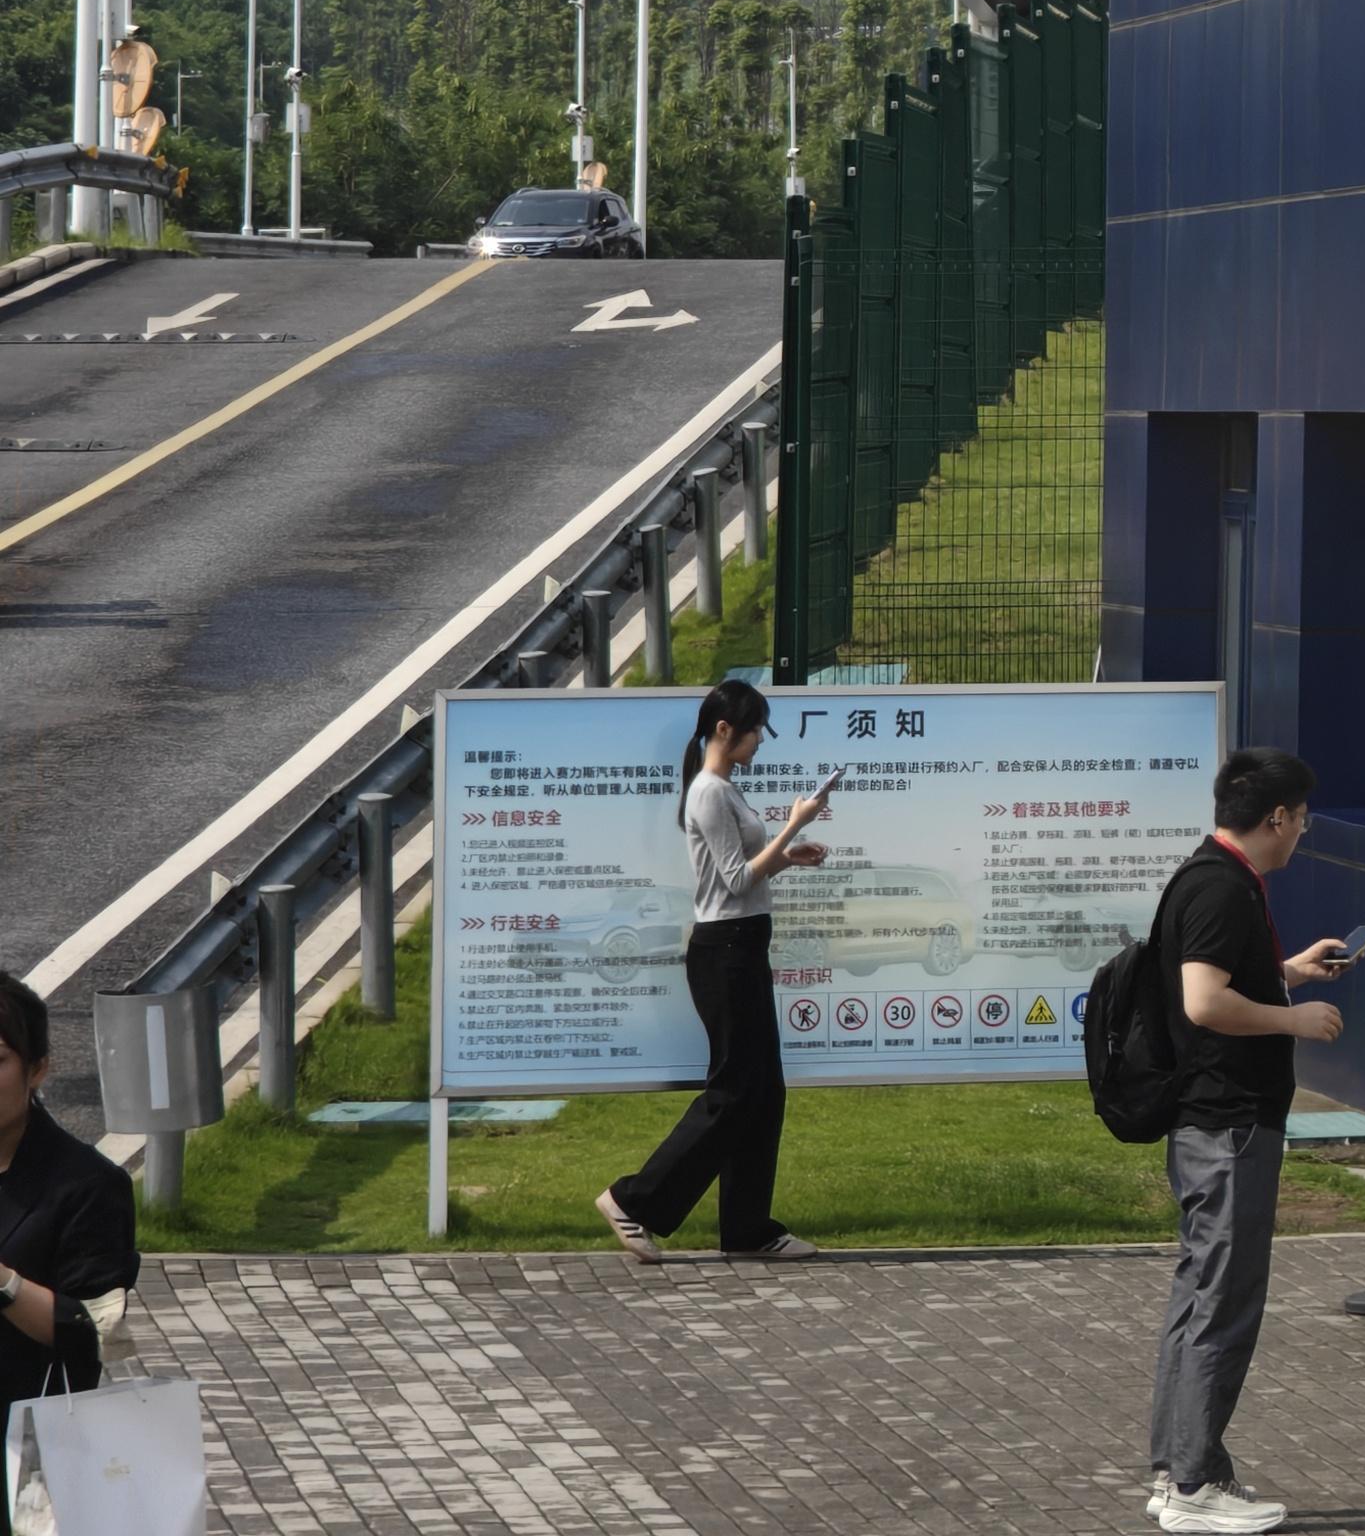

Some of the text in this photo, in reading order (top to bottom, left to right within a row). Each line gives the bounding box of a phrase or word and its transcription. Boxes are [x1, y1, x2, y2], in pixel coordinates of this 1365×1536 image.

[765, 708, 925, 739] 厂须知
[1012, 800, 1131, 818] 着装及其他要求
[492, 810, 562, 827] 信息安全
[490, 914, 561, 931] 行走安全
[890, 1005, 911, 1021] 30
[986, 1002, 1003, 1021] 停
